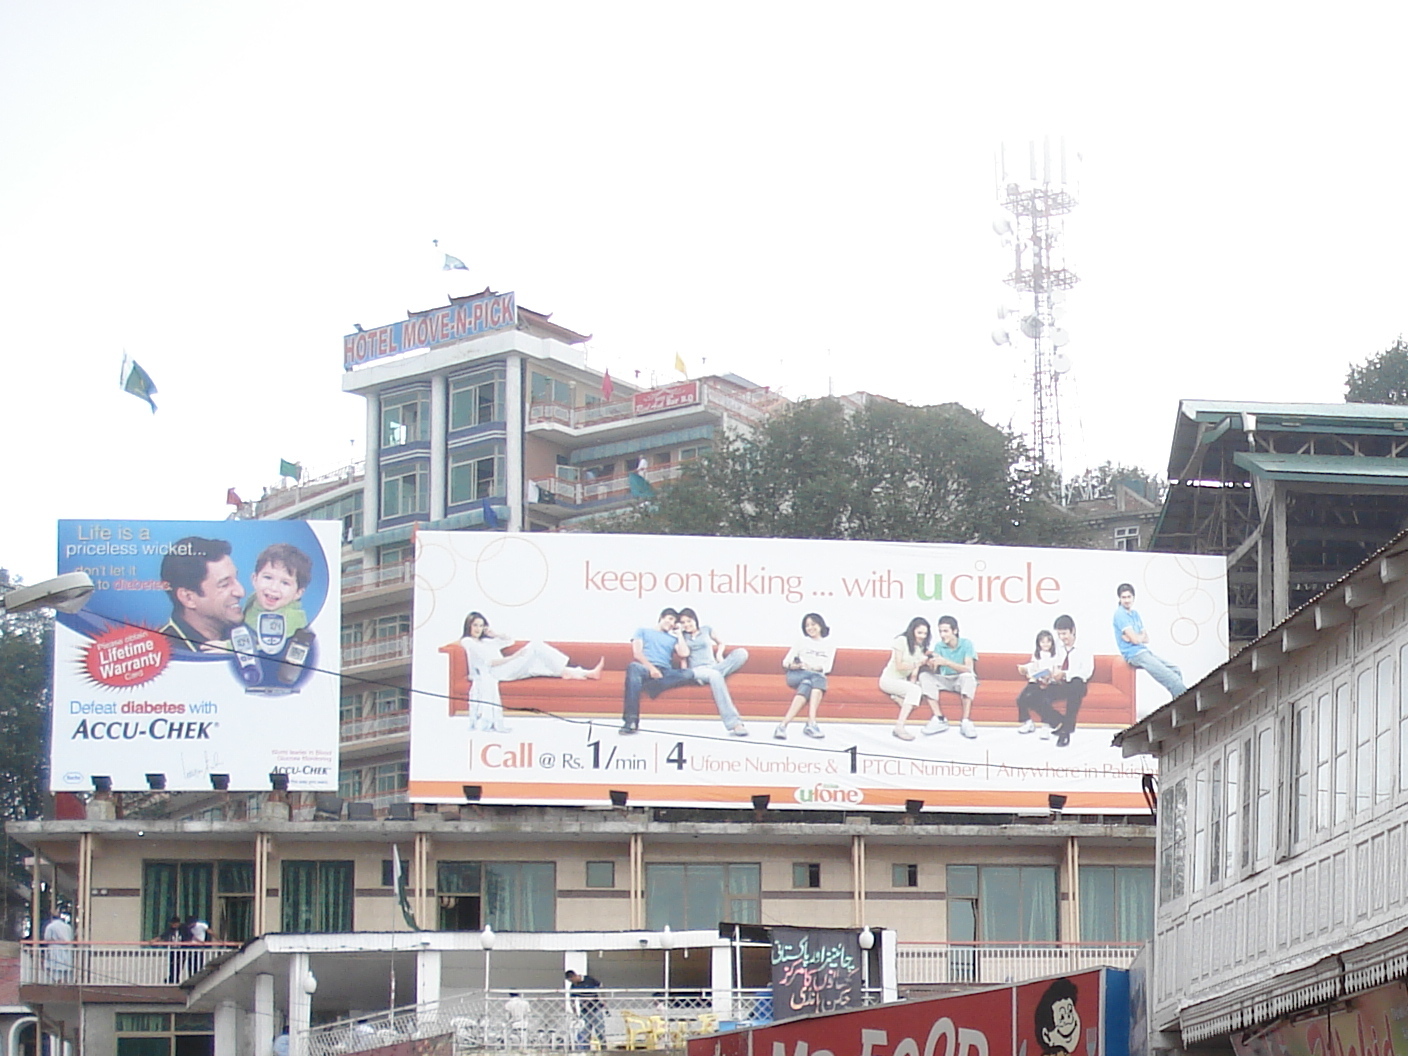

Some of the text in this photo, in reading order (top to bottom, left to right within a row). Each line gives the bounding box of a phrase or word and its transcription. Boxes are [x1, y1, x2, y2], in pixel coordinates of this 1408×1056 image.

[344, 294, 515, 365] HOTEL MOVE-N-PICK
[77, 525, 151, 541] Life is a
[66, 541, 138, 559] priceless
[110, 565, 126, 577] let
[129, 565, 138, 577] it
[98, 580, 110, 591] to
[584, 560, 658, 599] keep
[664, 571, 702, 593] on
[708, 564, 803, 603] talking
[841, 569, 904, 599] with
[99, 640, 154, 665] Lifetime
[100, 651, 162, 679] Warranty
[70, 700, 218, 715] Defeat diabetes with
[480, 742, 533, 769] Call
[562, 754, 585, 770] Rs.
[665, 742, 687, 770] 4
[690, 753, 741, 772] Ufone
[745, 754, 821, 774] Numbers
[825, 756, 839, 774] &
[845, 746, 857, 774] 1
[862, 760, 905, 776] PTCL
[910, 760, 978, 778] Number
[997, 762, 1070, 782] Anywhere
[800, 783, 858, 803] ufone
